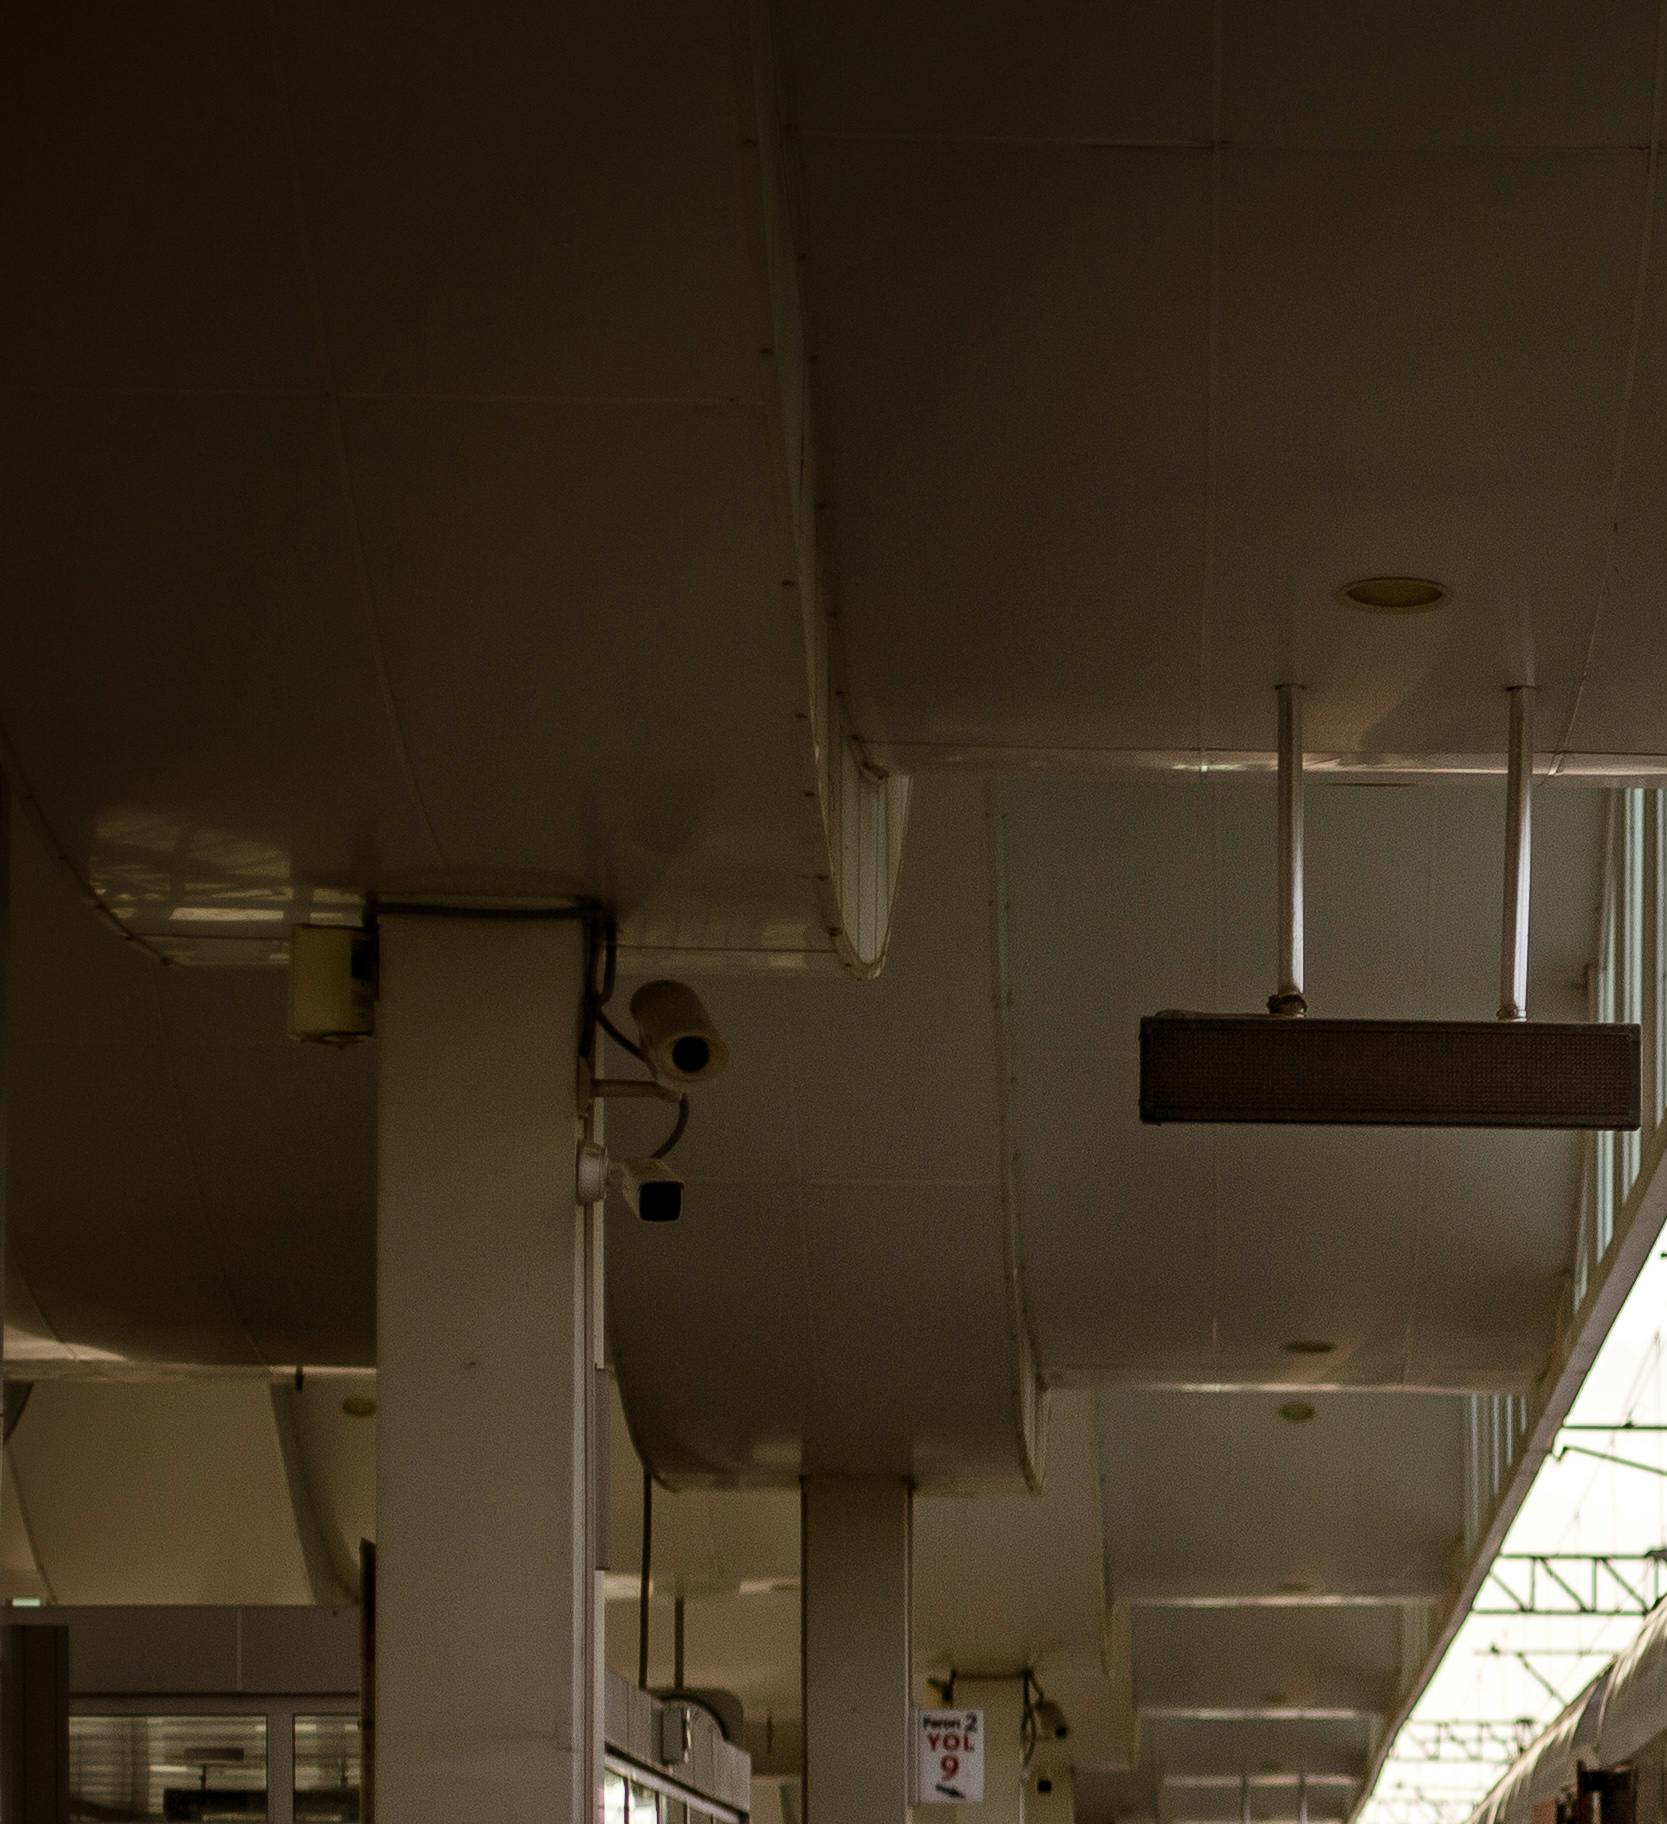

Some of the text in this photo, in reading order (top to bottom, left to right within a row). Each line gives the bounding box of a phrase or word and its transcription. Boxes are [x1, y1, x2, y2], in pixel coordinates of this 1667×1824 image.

[965, 1711, 979, 1731] 2
[928, 1733, 975, 1753] YOL
[941, 1755, 960, 1781] 9
